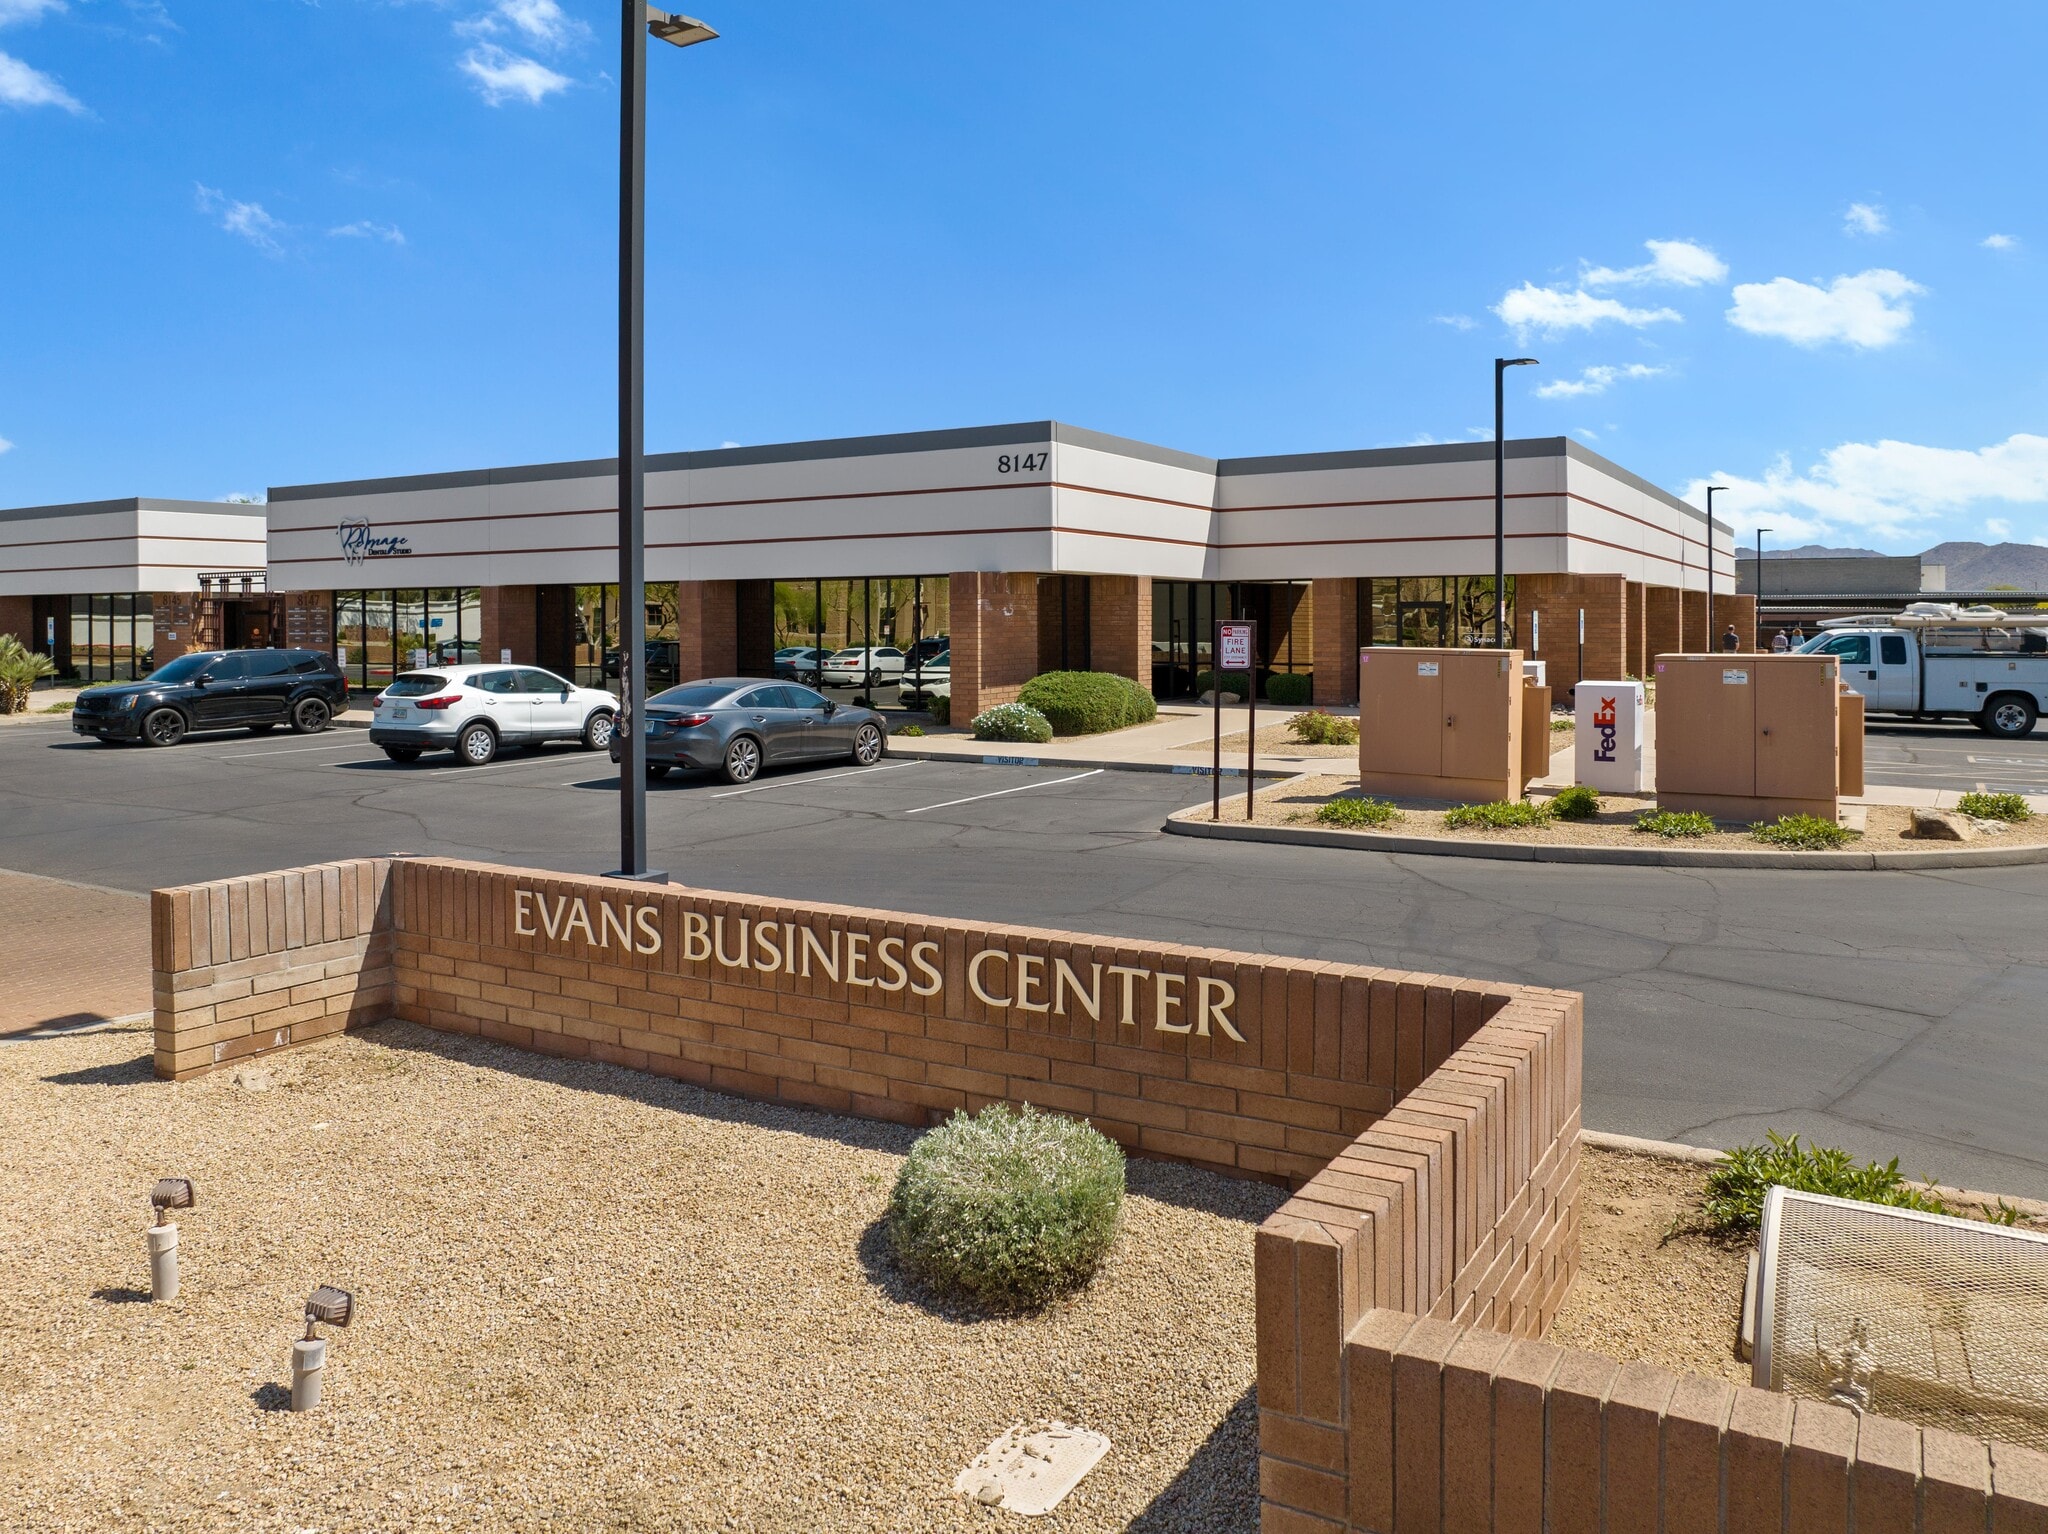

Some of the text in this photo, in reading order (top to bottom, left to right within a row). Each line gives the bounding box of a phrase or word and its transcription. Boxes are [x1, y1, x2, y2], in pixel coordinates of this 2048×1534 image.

[998, 452, 1049, 473] 8147
[162, 595, 182, 606] 8145
[297, 594, 320, 606] 8147
[1222, 628, 1232, 636] NO
[1227, 638, 1244, 646] FIRE
[1594, 697, 1616, 762] FedEx
[997, 756, 1025, 765] VISITOR
[513, 889, 1246, 1043] EVANS BUSINESS CENTER
